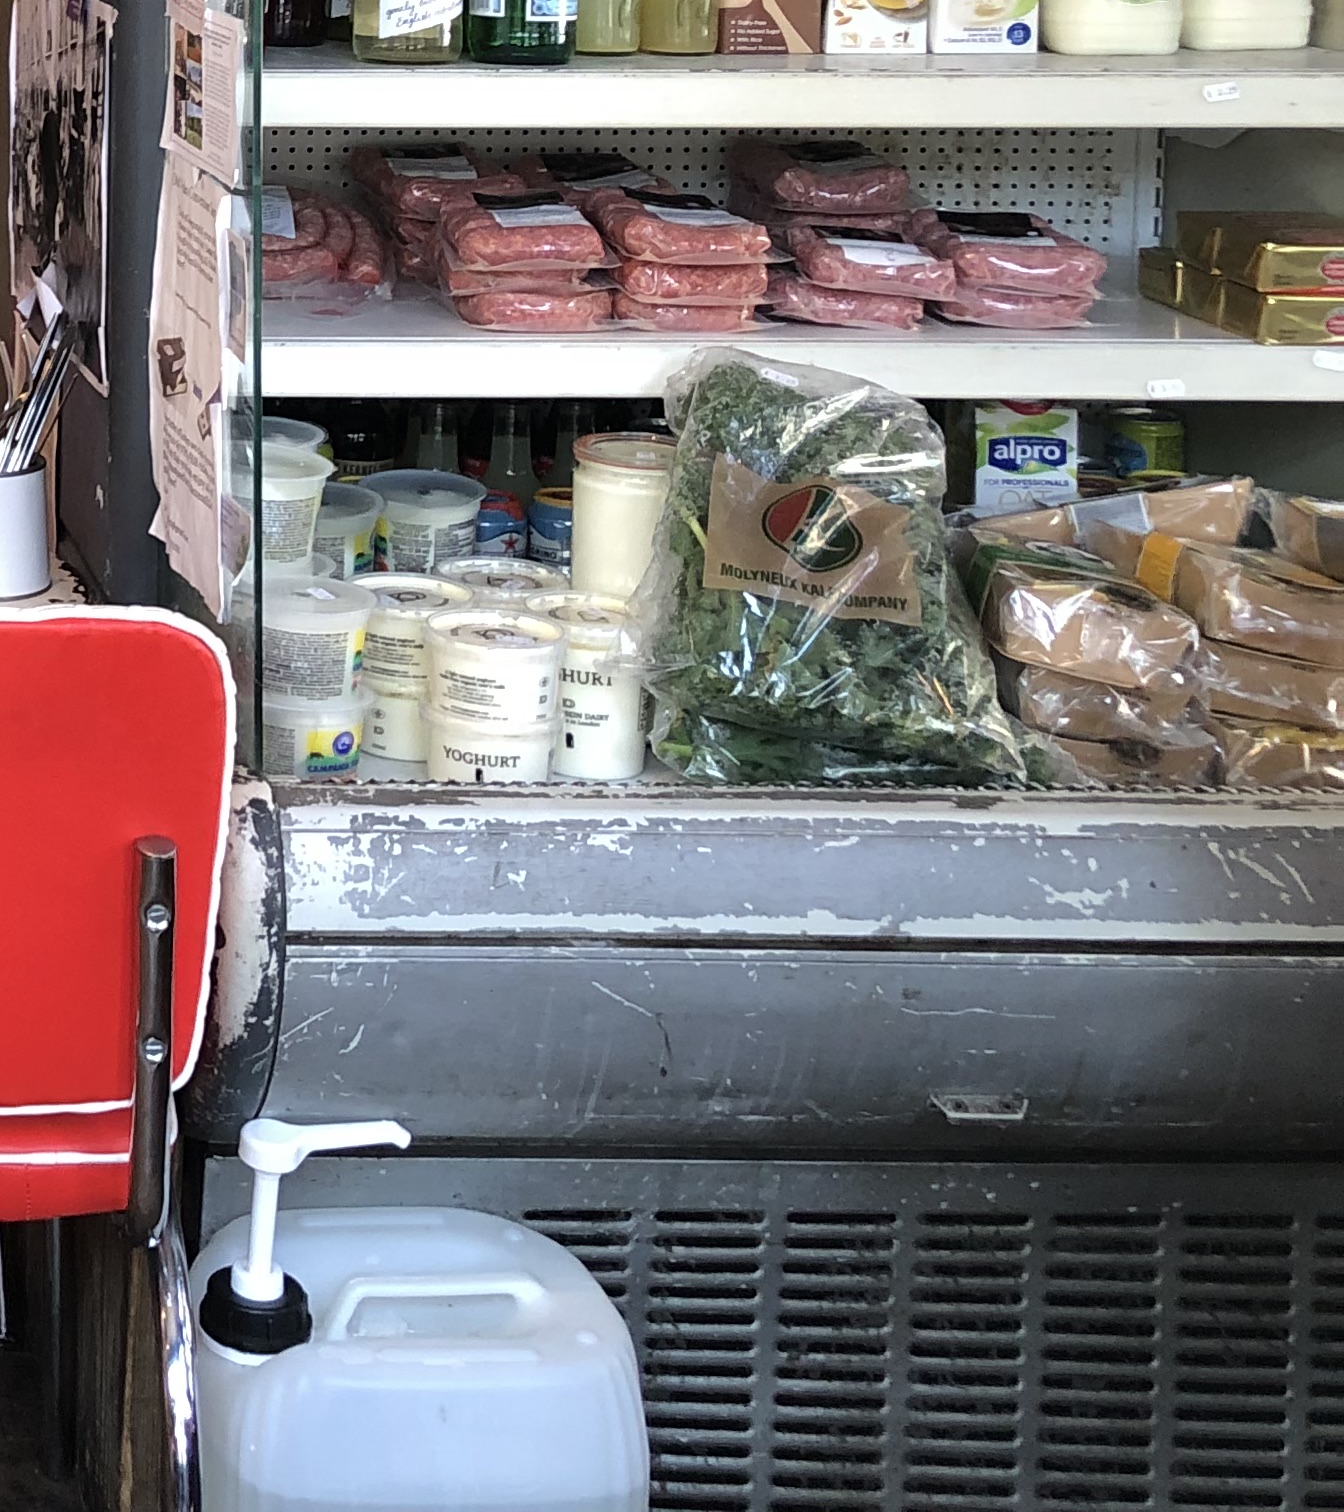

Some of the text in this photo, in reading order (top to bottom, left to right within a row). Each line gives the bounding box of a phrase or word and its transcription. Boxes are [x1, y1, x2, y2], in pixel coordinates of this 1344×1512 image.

[993, 439, 1062, 465] alpro
[1001, 479, 1070, 487] PROFESSIONALS
[719, 563, 909, 611] MOLYNEUX KAL OMPANY
[442, 745, 521, 769] YOGHURT
